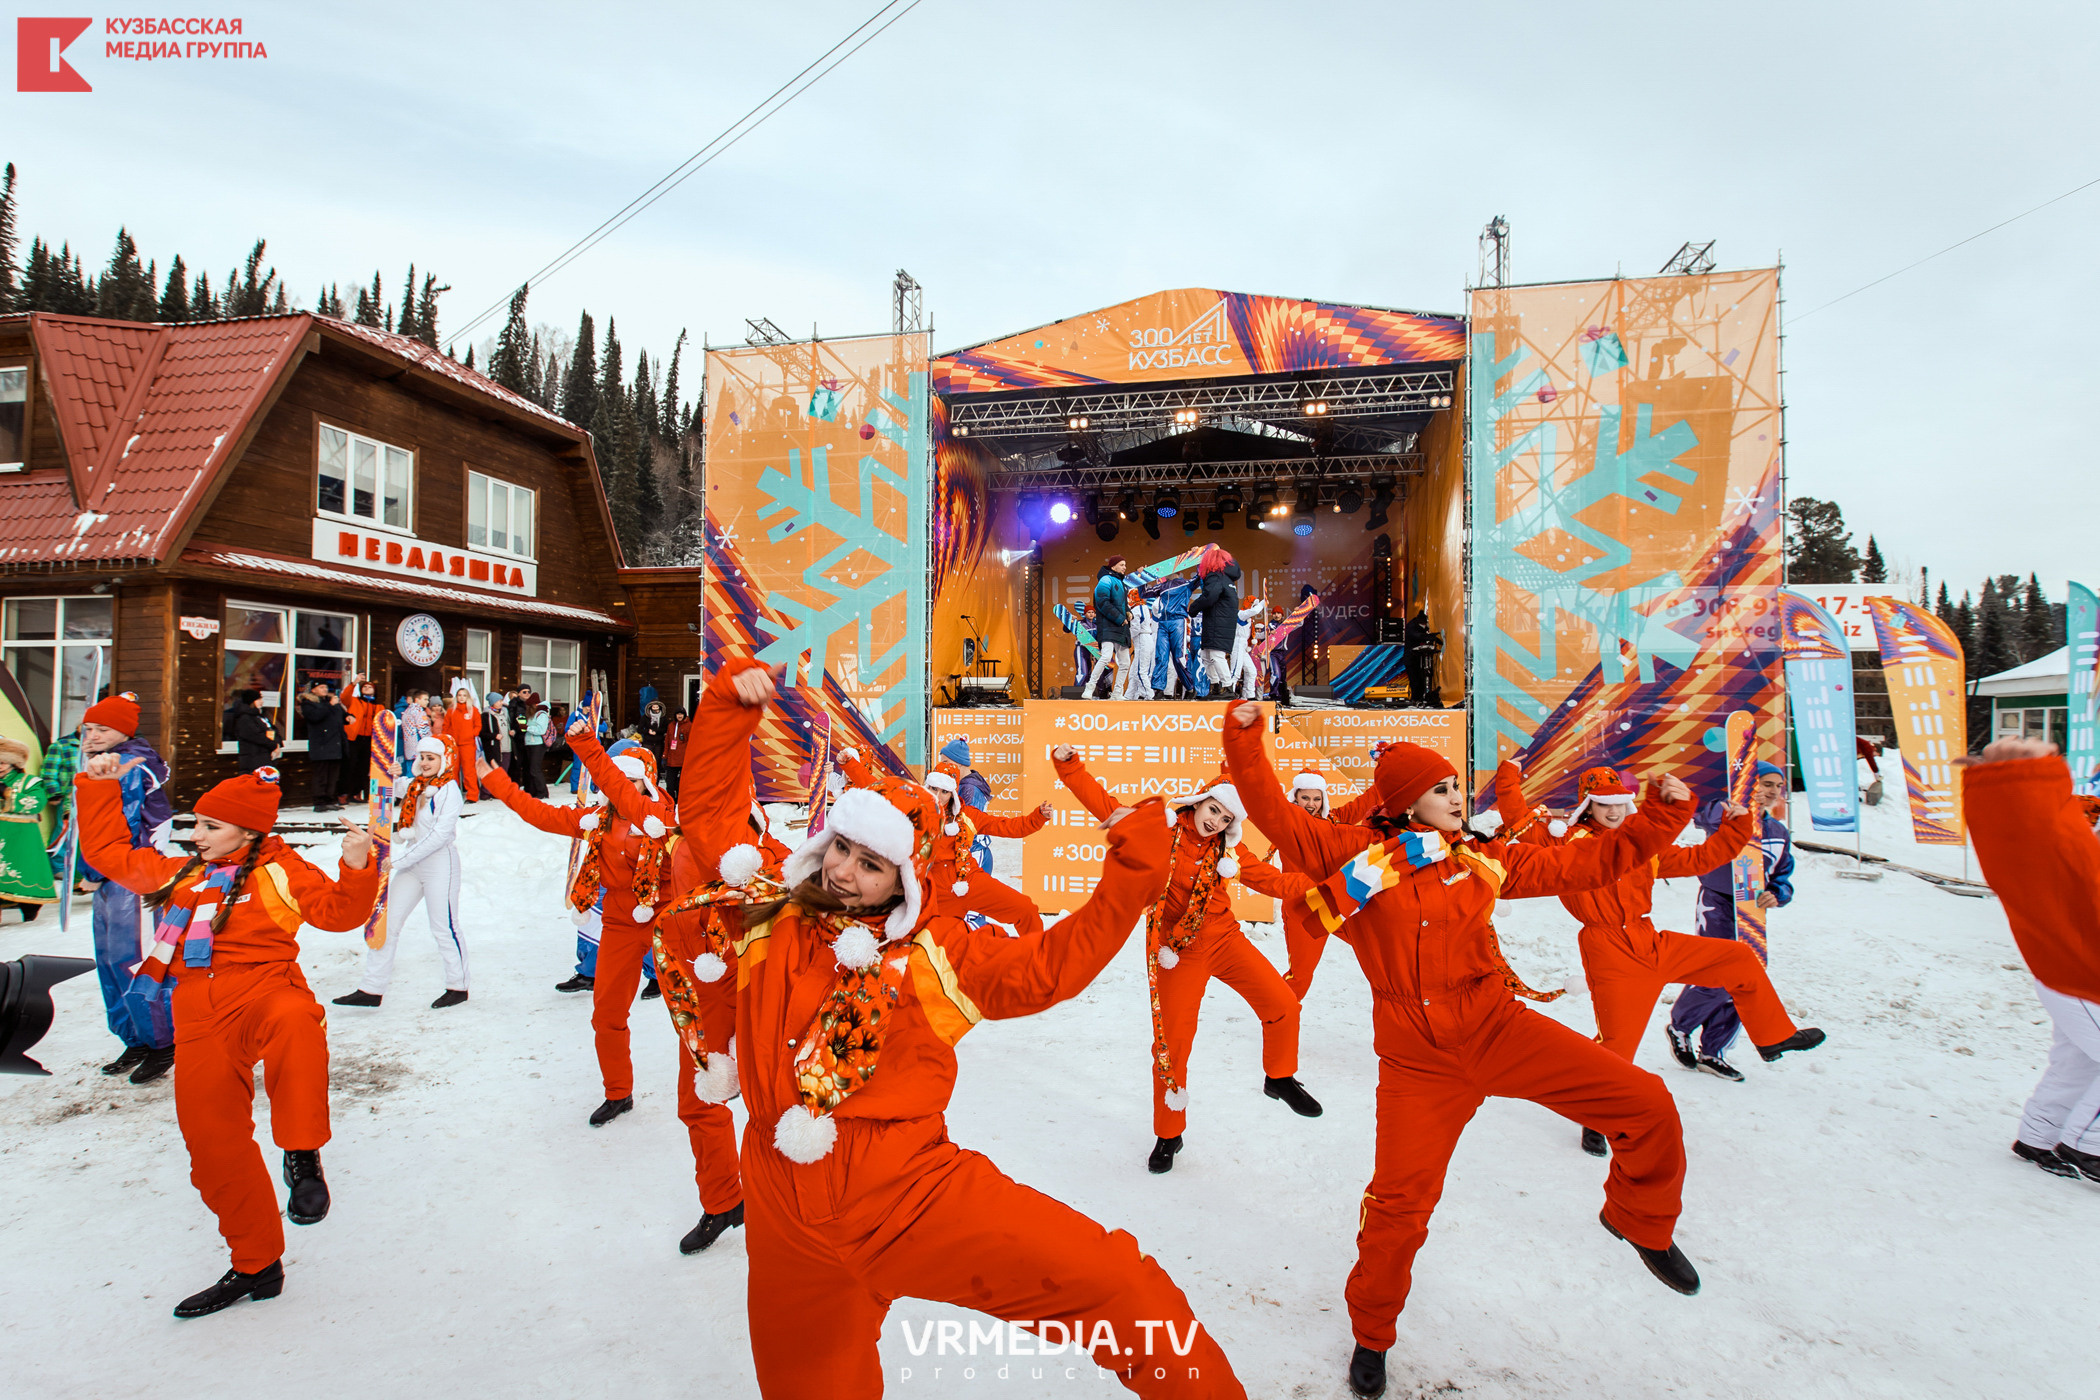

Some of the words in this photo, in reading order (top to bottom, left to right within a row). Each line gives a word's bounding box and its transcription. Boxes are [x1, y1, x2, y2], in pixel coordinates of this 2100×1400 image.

[1129, 327, 1174, 349] 300
[1128, 343, 1234, 371] КУЗБАСС
[338, 530, 526, 588] НЕВАЛЯШКА
